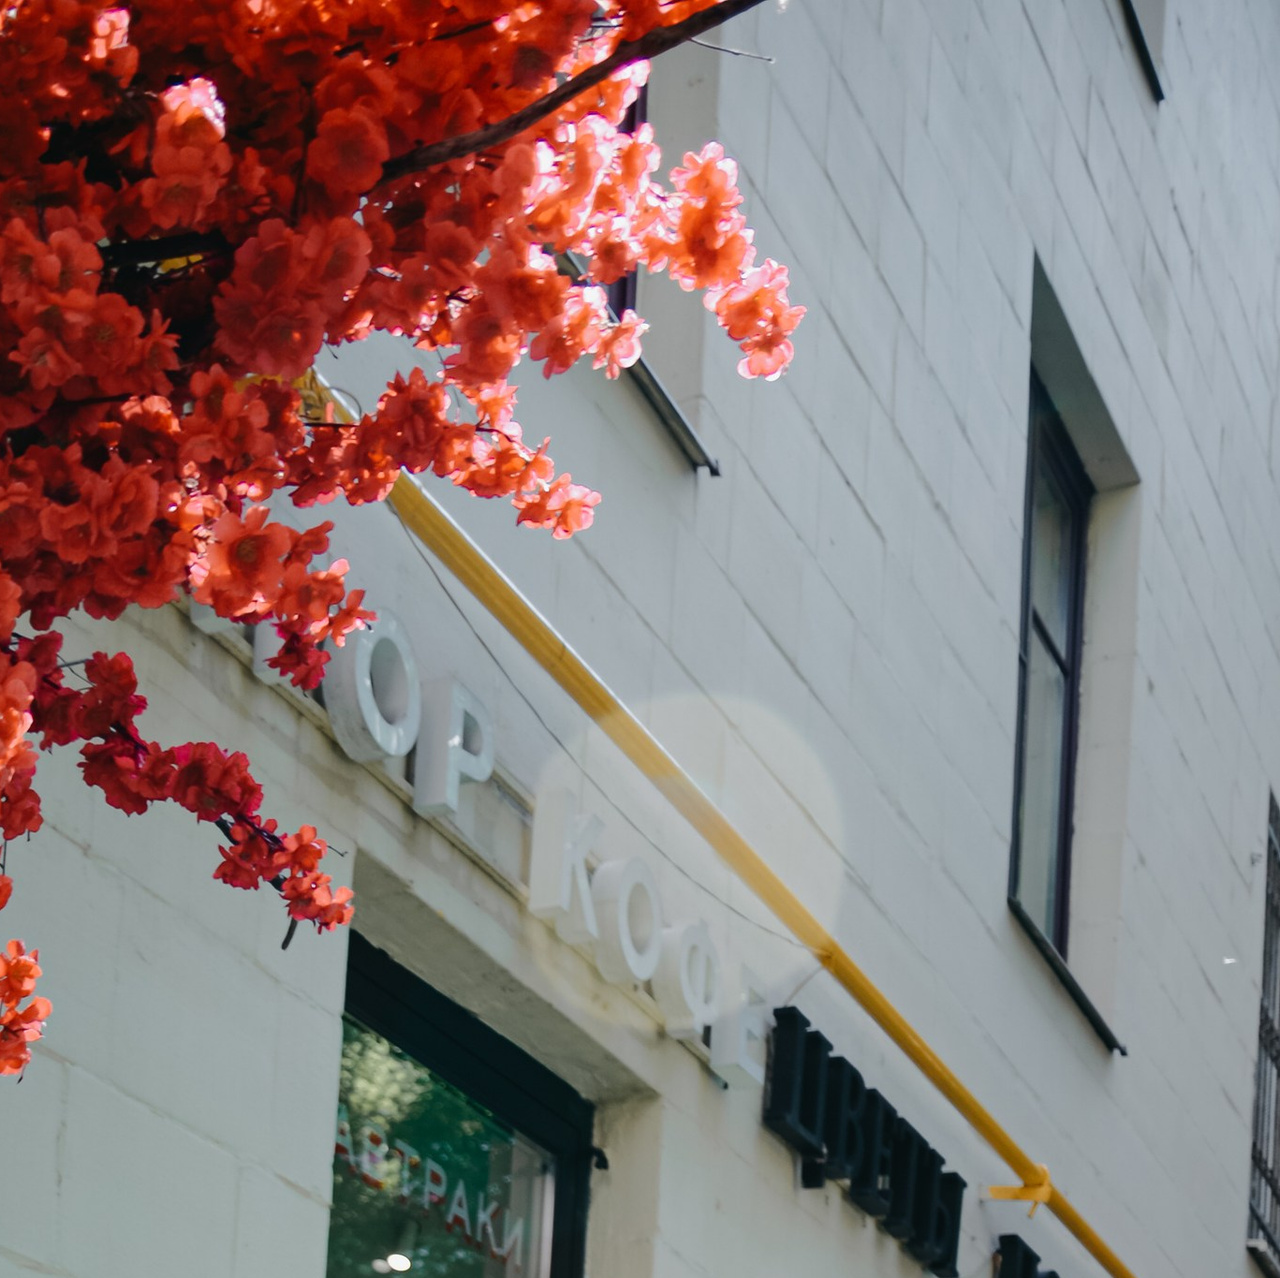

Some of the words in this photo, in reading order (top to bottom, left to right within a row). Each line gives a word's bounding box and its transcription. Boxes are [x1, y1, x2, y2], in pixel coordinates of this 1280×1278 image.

[529, 786, 771, 1090] КОФЕ
[333, 1103, 525, 1270] АВТРАКИ
[763, 1006, 967, 1278] ЦВЕТЫ
